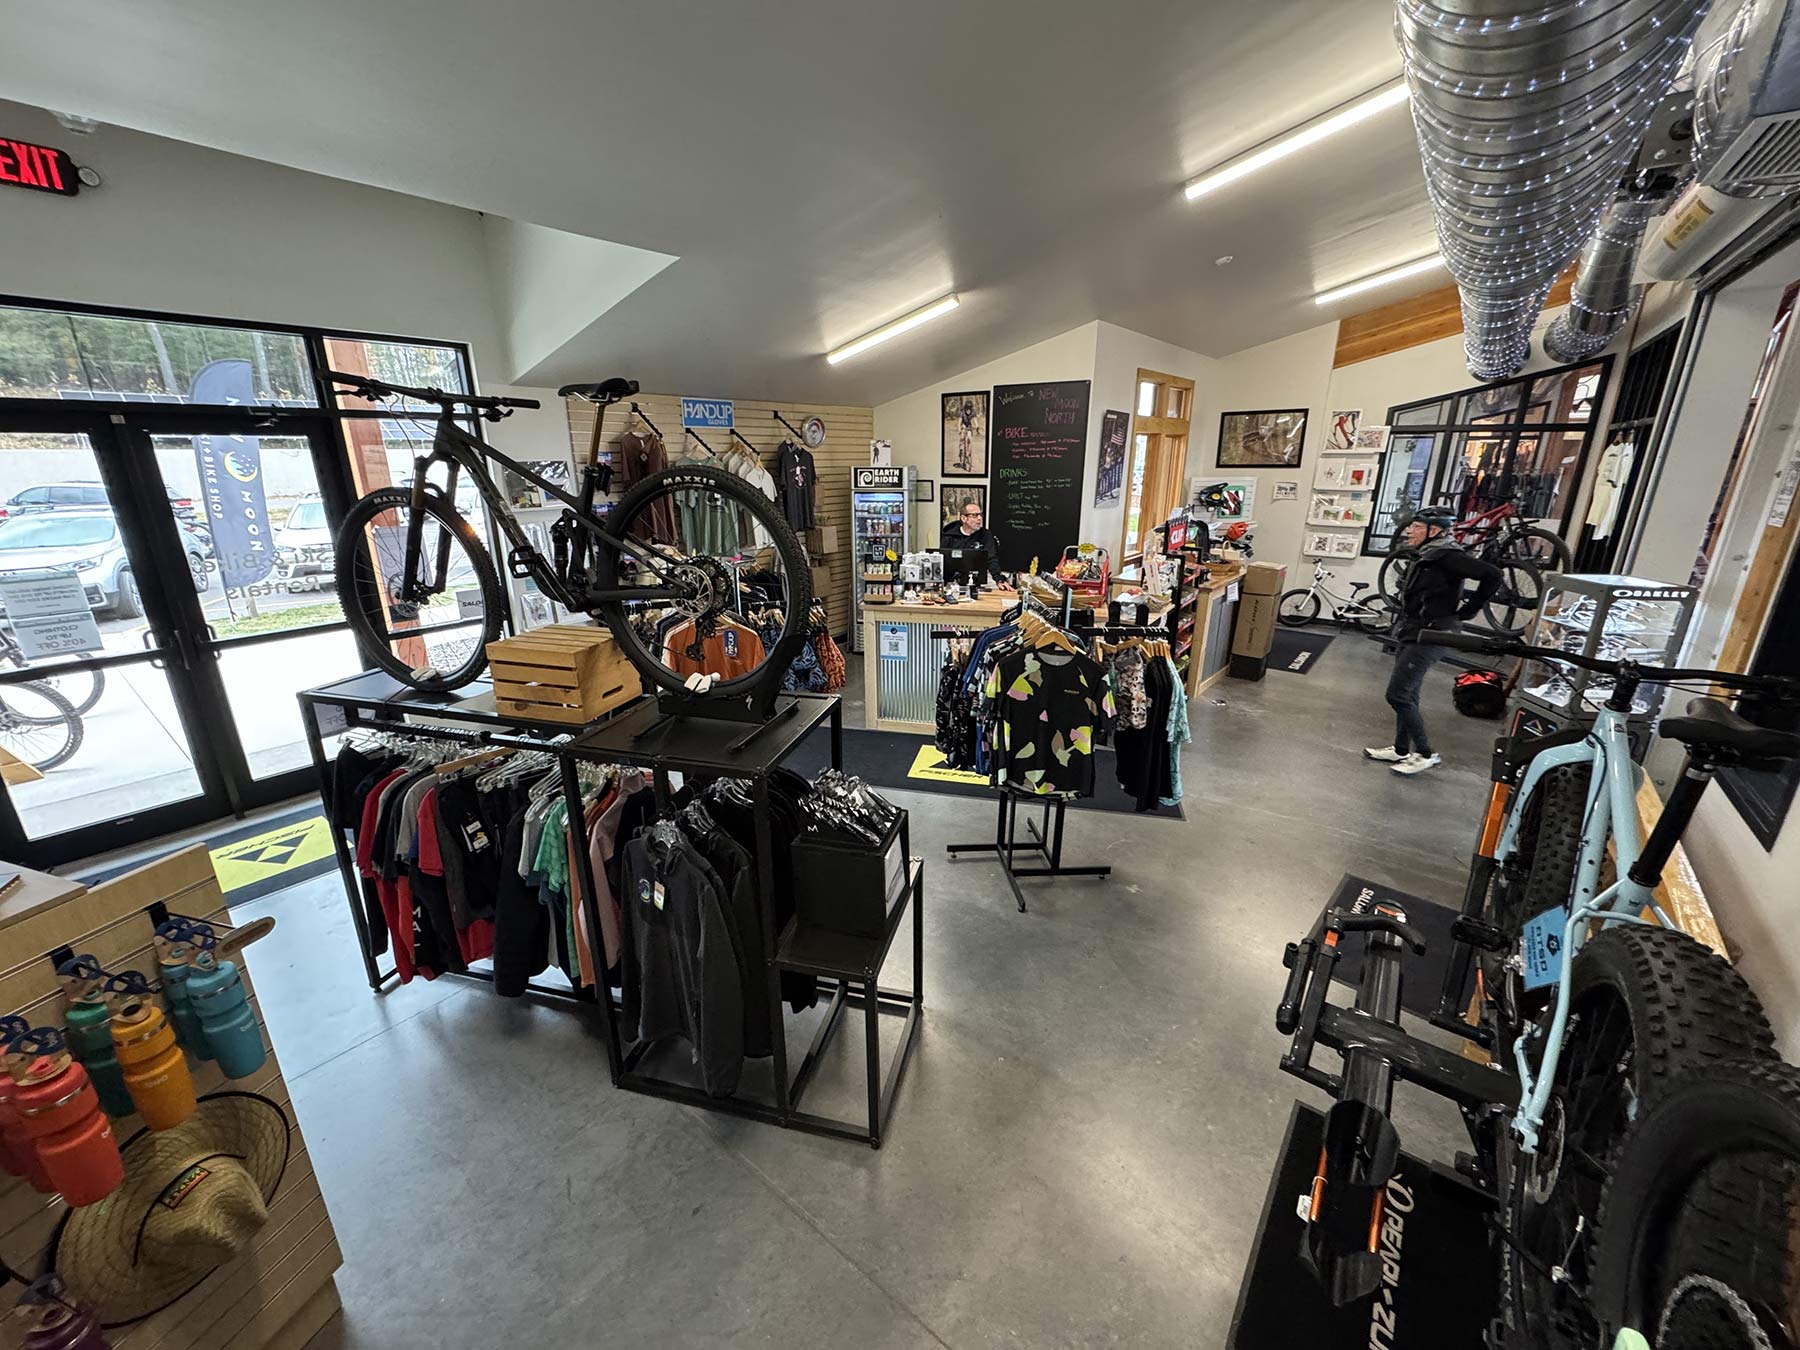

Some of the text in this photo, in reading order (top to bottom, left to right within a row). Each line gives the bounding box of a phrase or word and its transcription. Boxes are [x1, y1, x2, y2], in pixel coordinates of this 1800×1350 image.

[0, 139, 65, 190] EXIT
[683, 402, 733, 419] HANDUP
[1044, 408, 1076, 424] NORTH
[1005, 427, 1029, 439] BIKE
[203, 456, 217, 484] BIKE
[1000, 468, 1028, 479] DRINKS
[662, 475, 716, 486] MAXXIS
[208, 488, 224, 520] SHOP
[373, 495, 408, 504] MAXXI
[240, 490, 265, 551] MOON
[1633, 590, 1690, 598] OAKLEY
